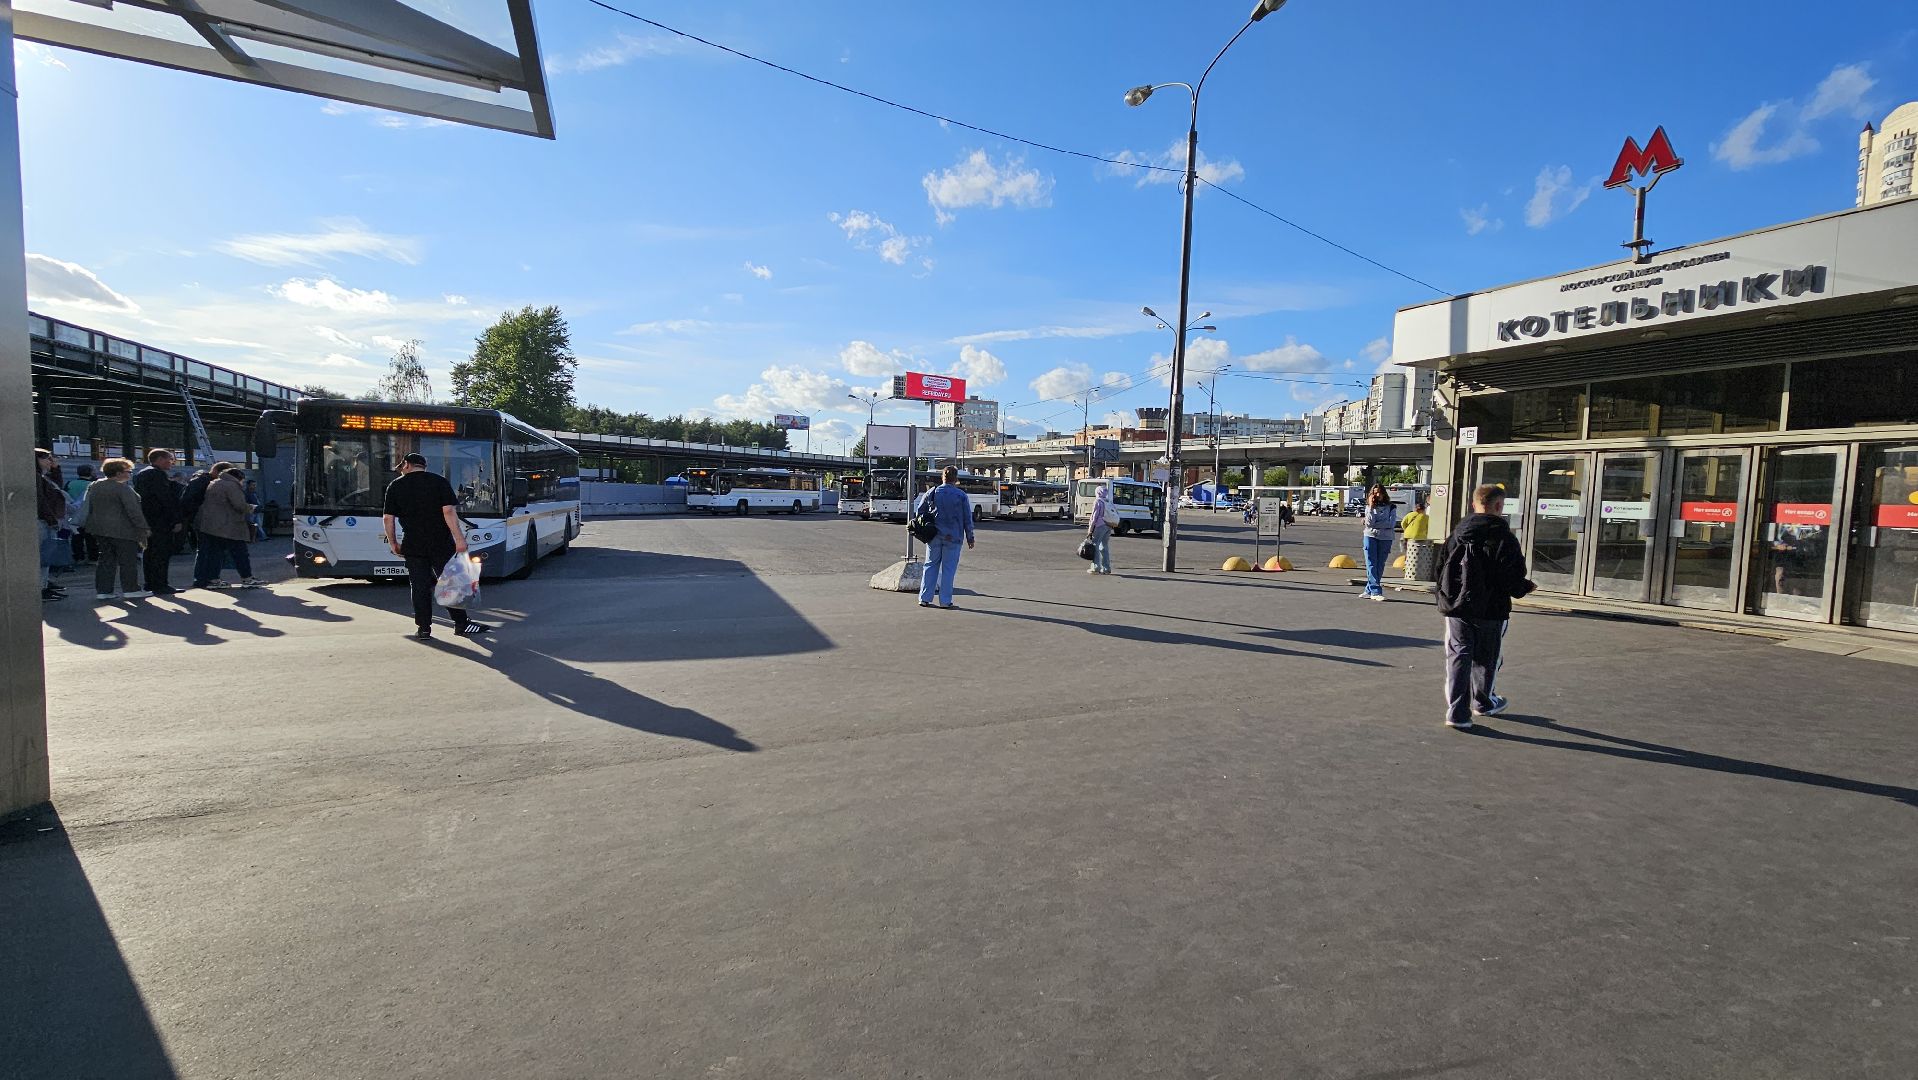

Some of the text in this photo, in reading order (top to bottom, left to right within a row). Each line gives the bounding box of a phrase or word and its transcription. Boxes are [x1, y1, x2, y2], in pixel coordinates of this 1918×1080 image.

[1560, 252, 1731, 293] МОСКОВСКИЙ МЕТРОПОЛИТЕН
[1611, 277, 1664, 293] СТАНЦИЯ
[1497, 265, 1828, 342] КОТЕЛЬНИКИ
